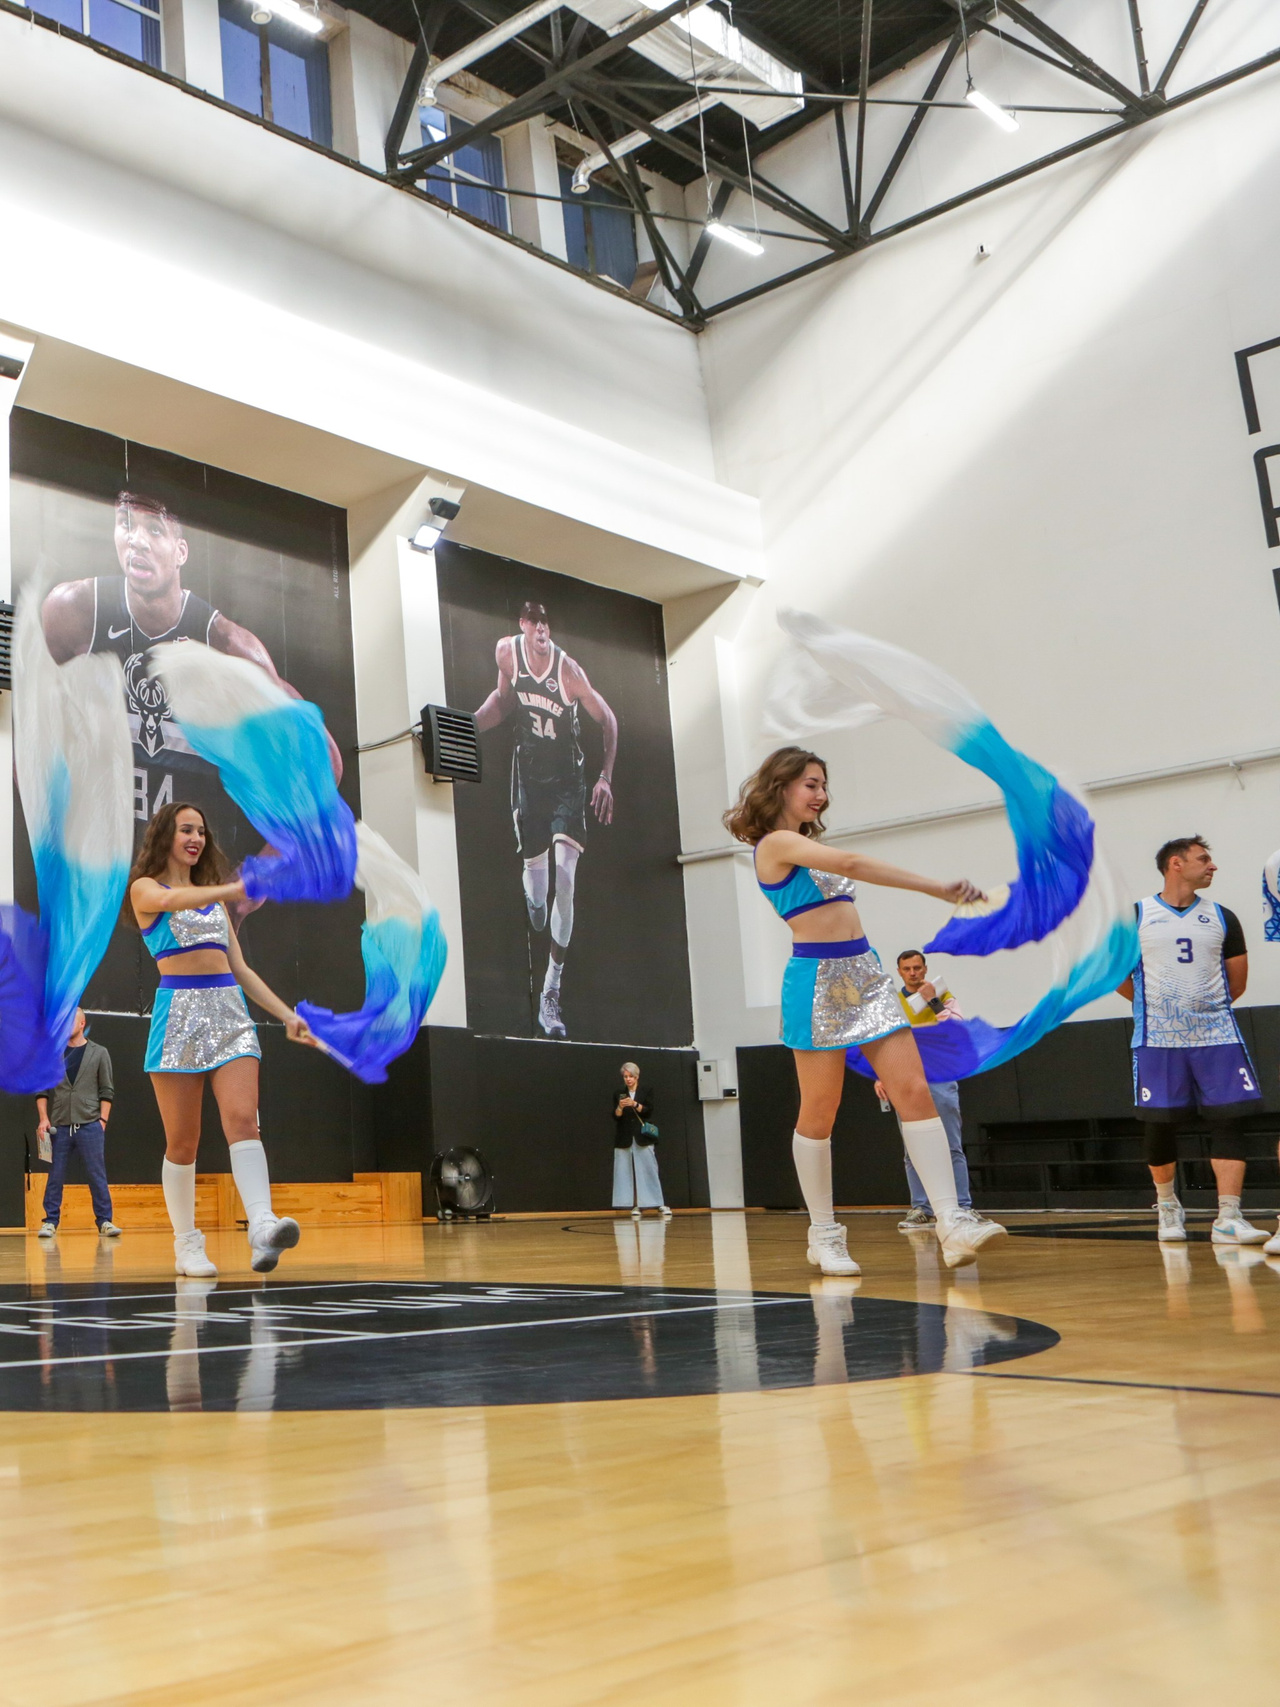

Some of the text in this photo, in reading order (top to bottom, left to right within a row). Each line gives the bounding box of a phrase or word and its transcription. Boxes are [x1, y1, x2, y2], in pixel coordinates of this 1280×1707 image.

[529, 711, 557, 740] 34
[1175, 938, 1194, 964] 3
[1238, 1067, 1255, 1091] 3
